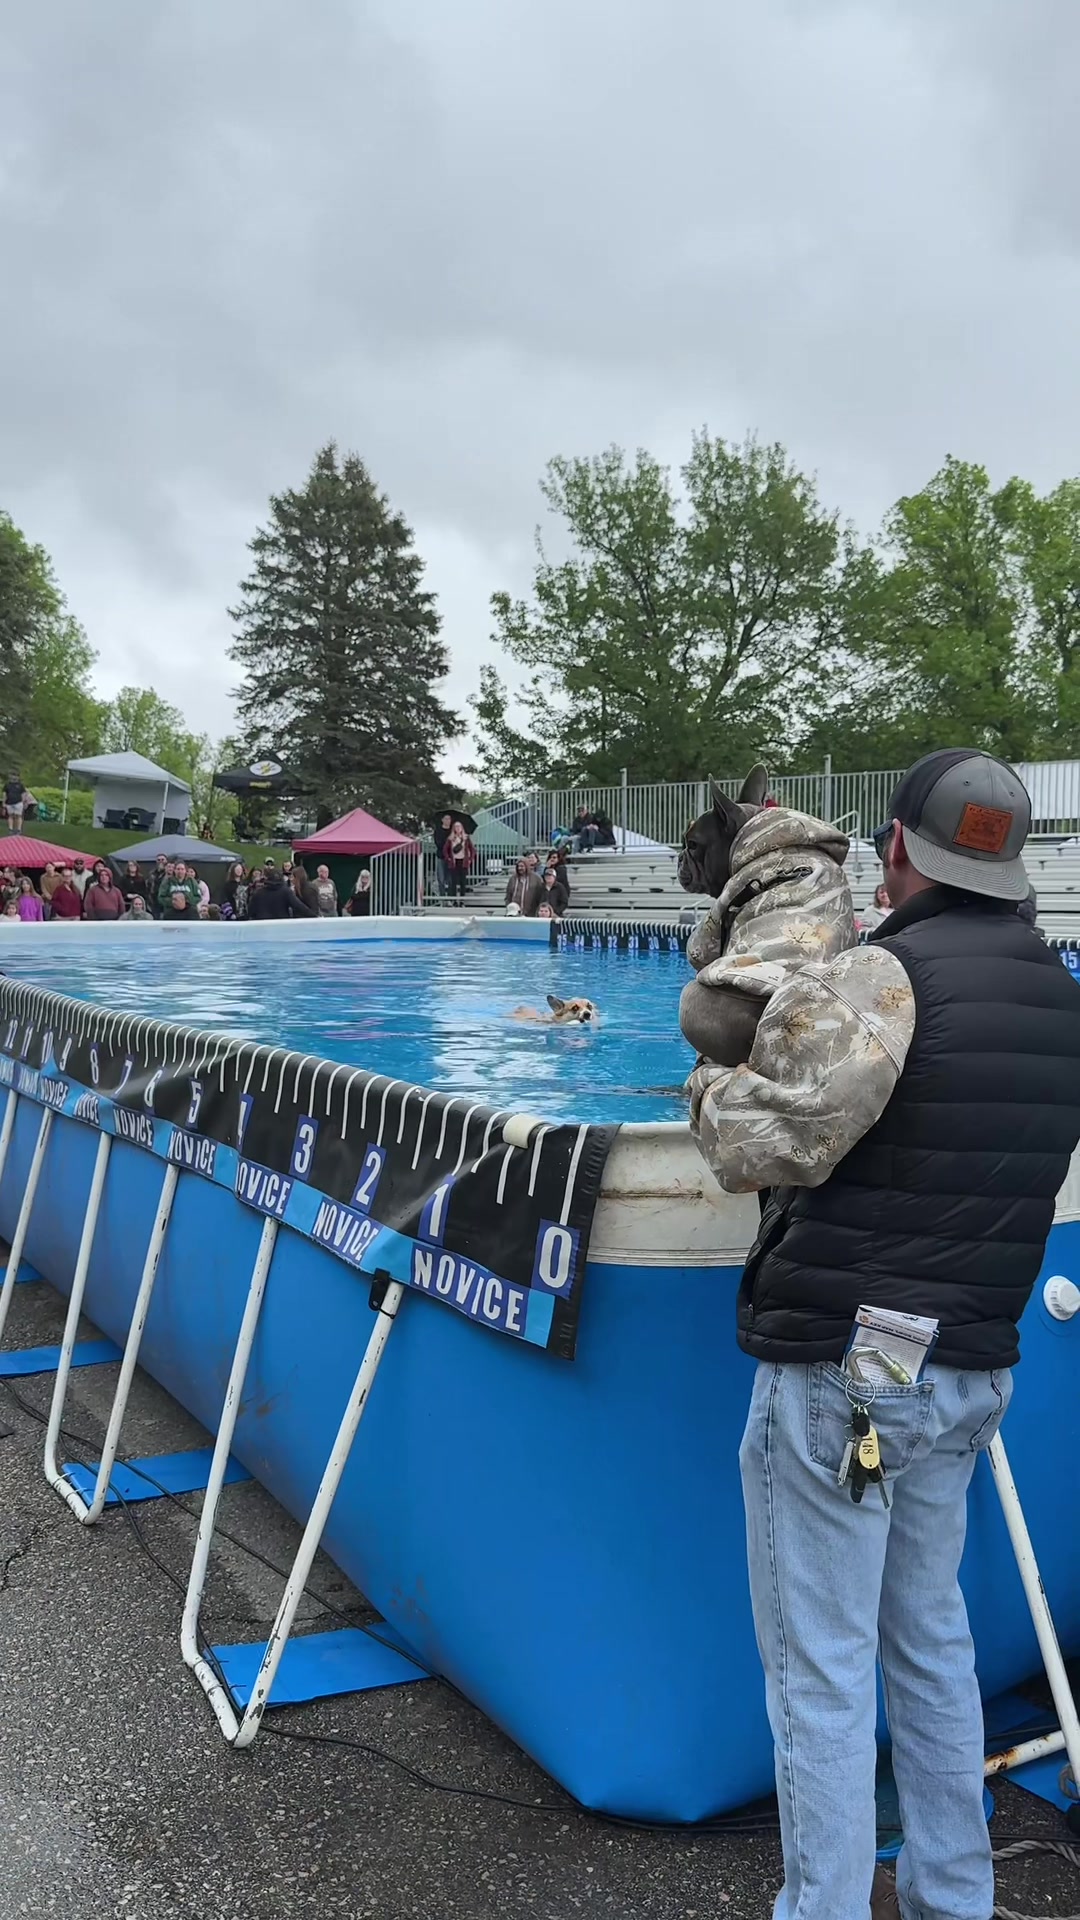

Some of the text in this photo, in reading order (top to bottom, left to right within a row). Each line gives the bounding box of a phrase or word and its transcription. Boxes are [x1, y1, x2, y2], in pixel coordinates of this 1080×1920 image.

[1060, 951, 1078, 969] 15
[89, 1048, 100, 1085] 8
[114, 1059, 134, 1095] 7
[143, 1069, 163, 1108] 6
[187, 1080, 202, 1124] 5
[112, 1108, 154, 1147] NOVICE
[293, 1122, 315, 1174] 3
[167, 1129, 216, 1175] NOVICE
[235, 1161, 292, 1216] OVICE
[355, 1150, 382, 1206] 2
[428, 1182, 450, 1238] 1
[538, 1225, 573, 1289] 0
[412, 1247, 525, 1333] NOVICE
[861, 1437, 874, 1455] 148
